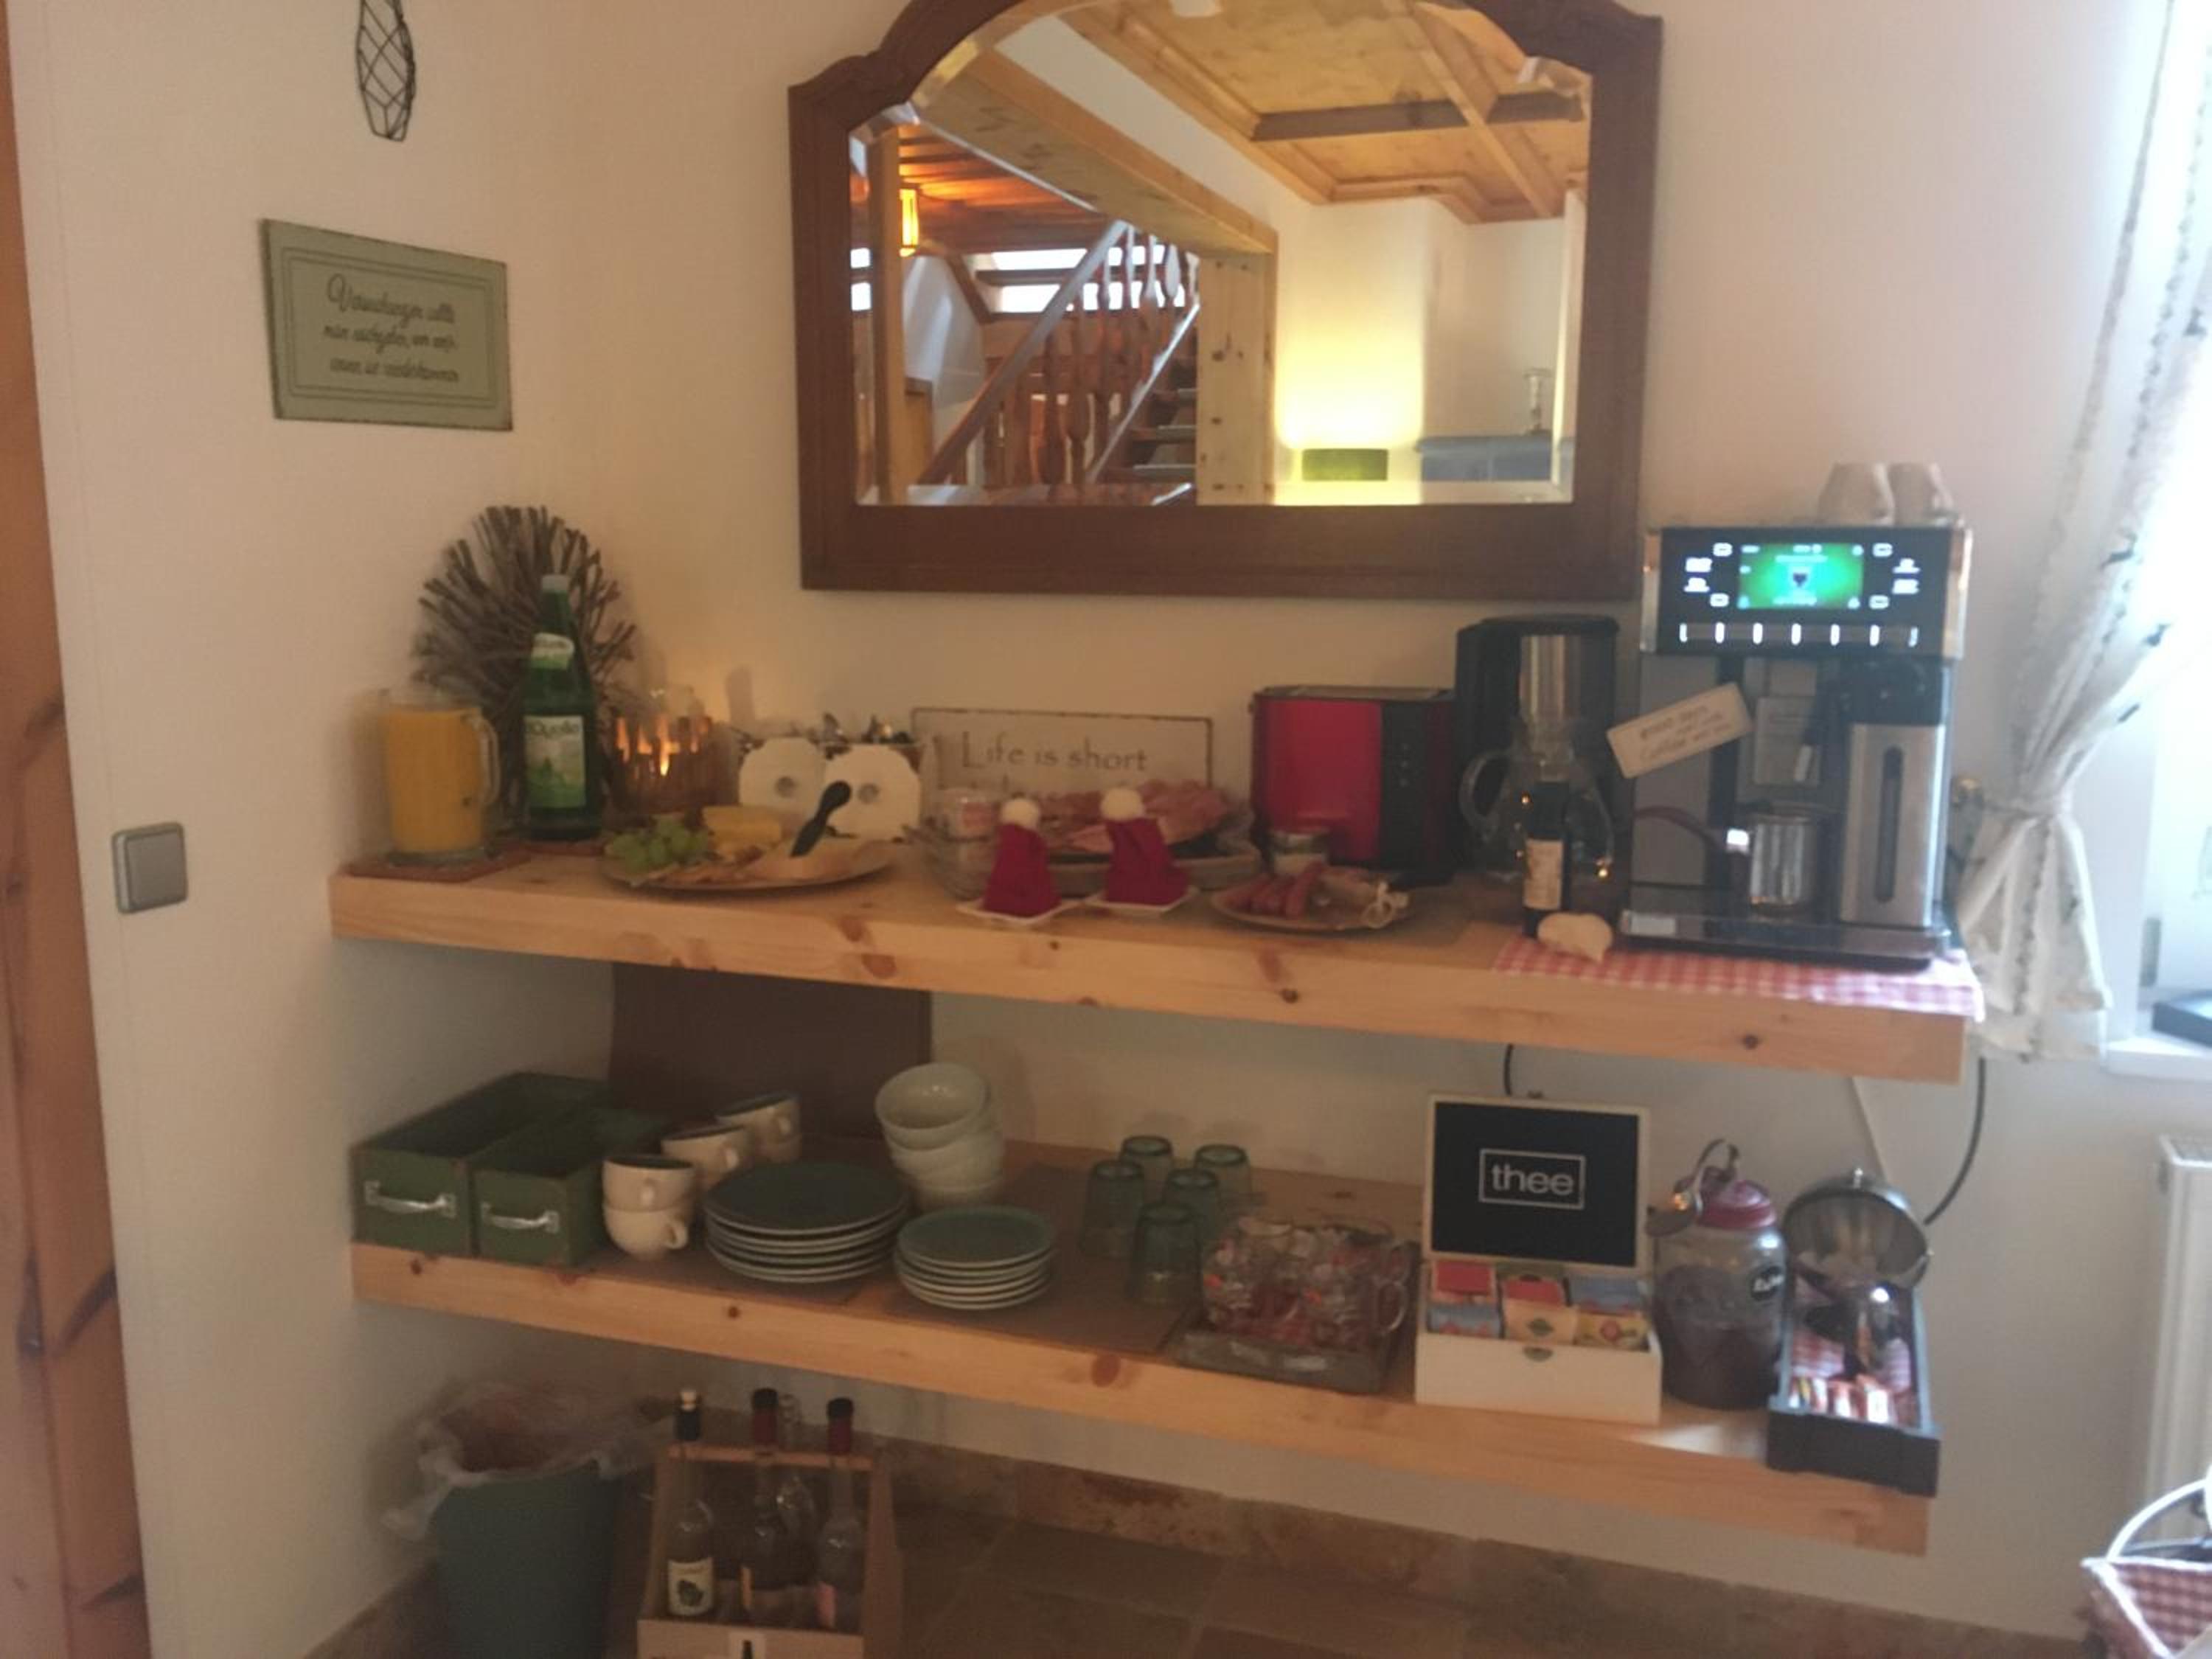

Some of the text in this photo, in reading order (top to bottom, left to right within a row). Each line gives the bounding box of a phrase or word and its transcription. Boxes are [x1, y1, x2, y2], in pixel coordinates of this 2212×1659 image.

[961, 731, 1147, 771] Life is short
[1491, 1163, 1574, 1196] thee
